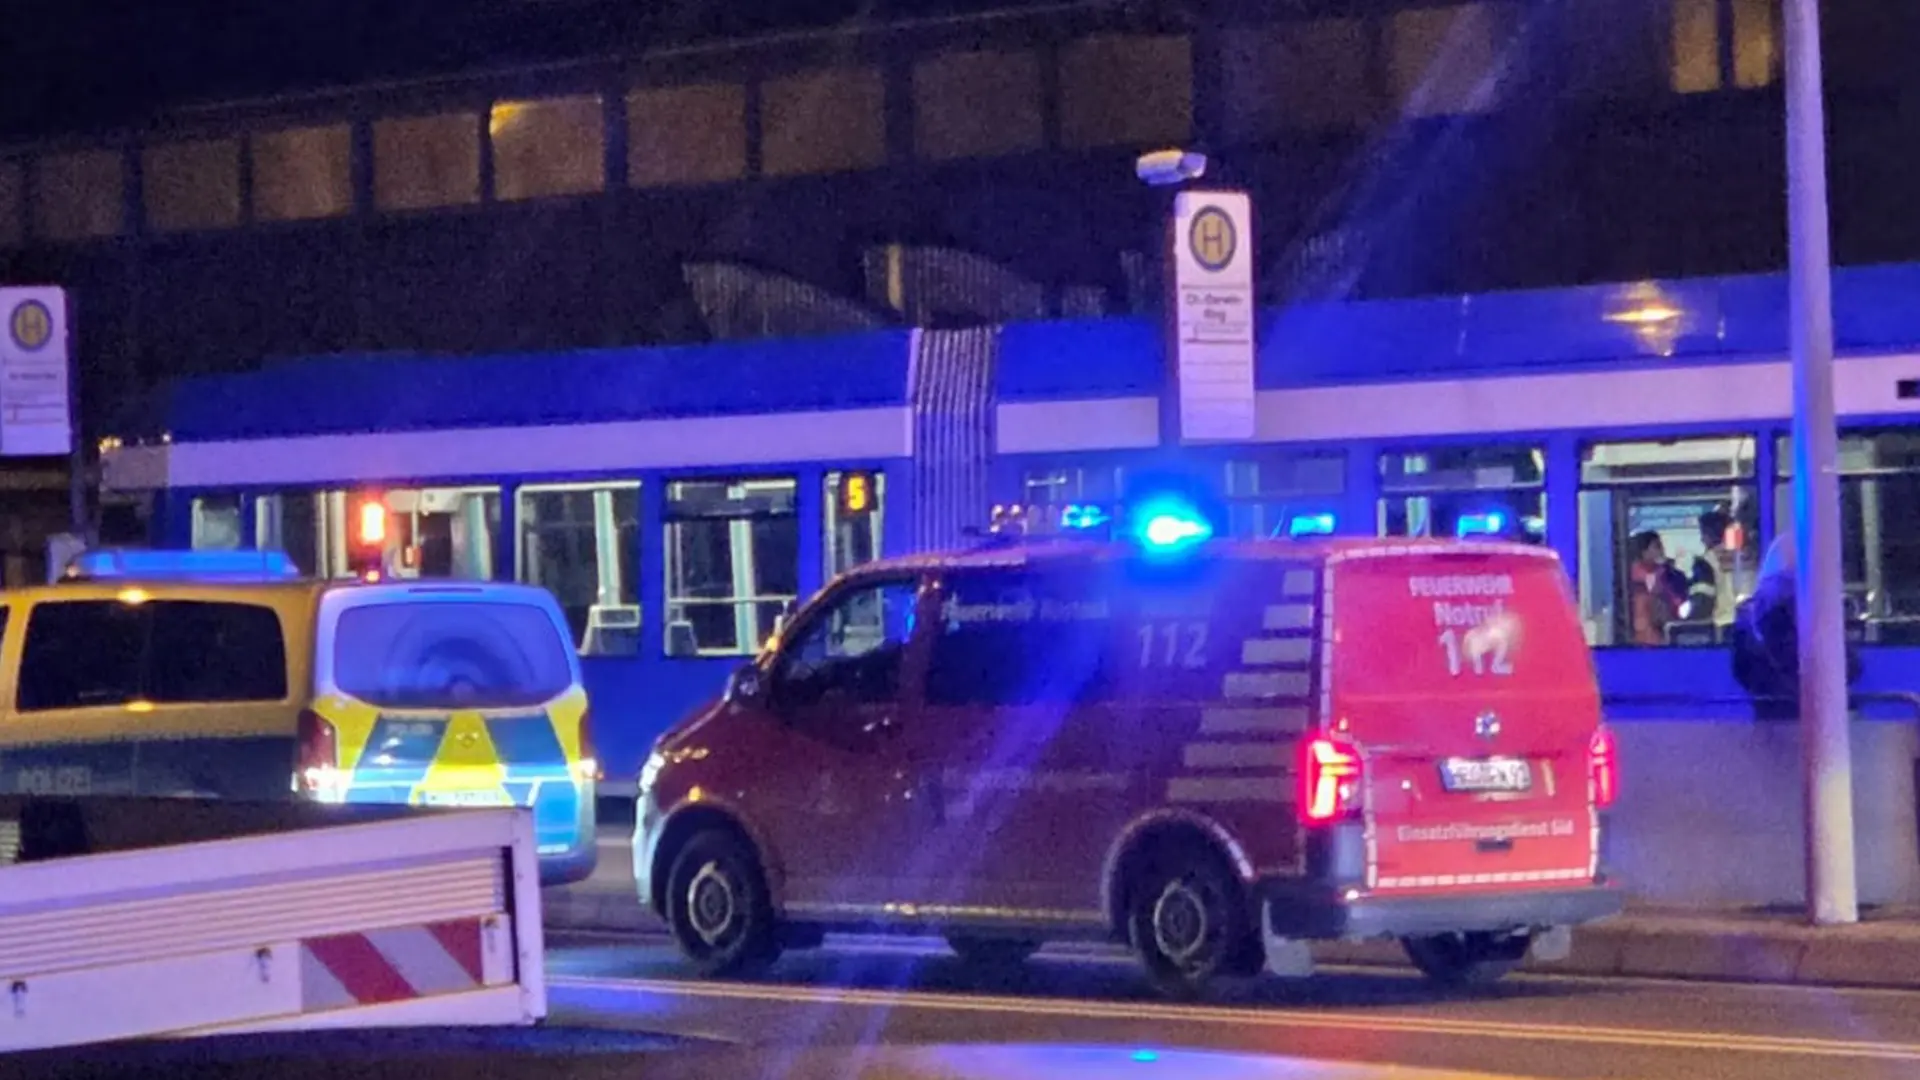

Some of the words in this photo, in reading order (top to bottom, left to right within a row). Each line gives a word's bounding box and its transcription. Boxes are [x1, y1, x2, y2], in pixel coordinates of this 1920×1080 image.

[1202, 220, 1223, 256] H
[847, 477, 866, 510] 5
[1409, 574, 1514, 597] FEUERWEHR
[1137, 621, 1209, 669] 112
